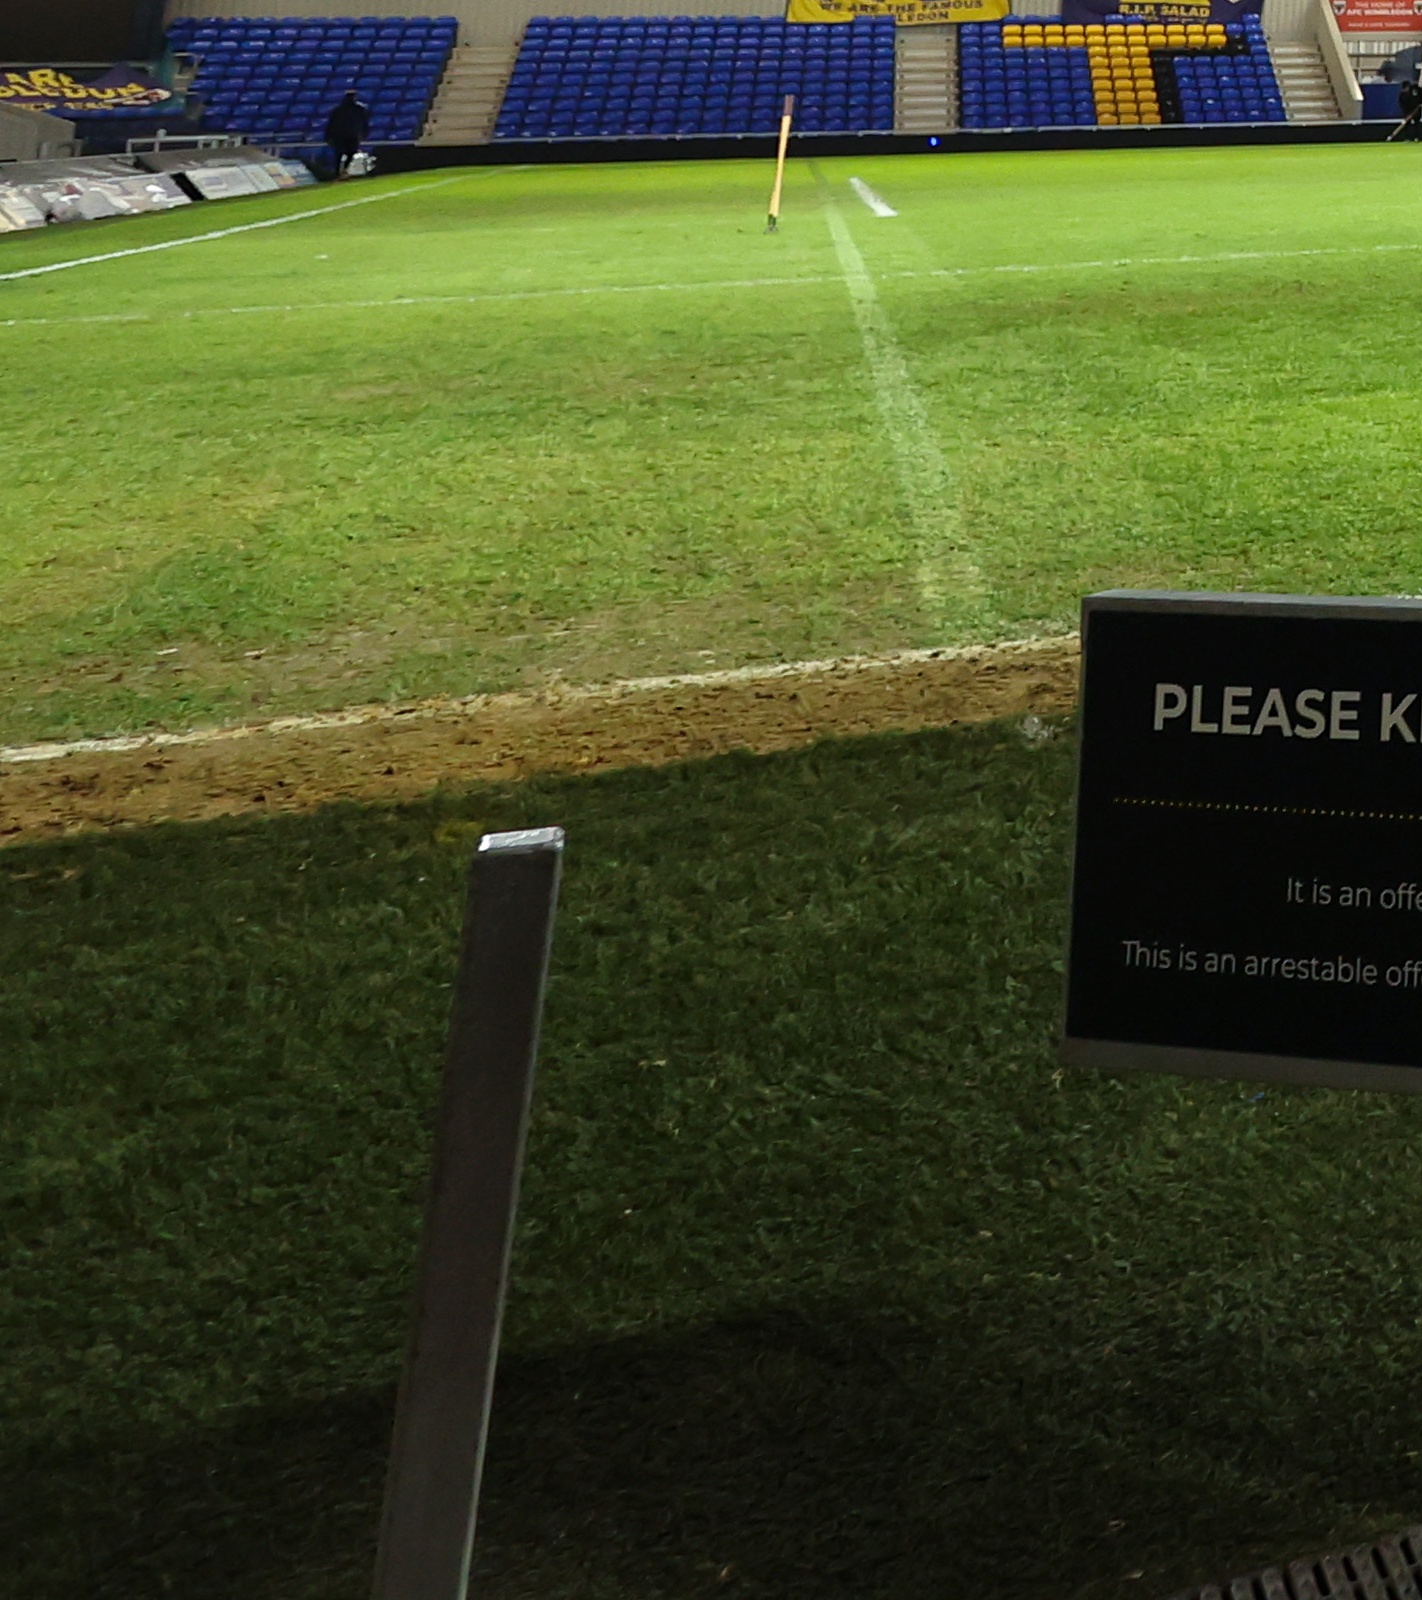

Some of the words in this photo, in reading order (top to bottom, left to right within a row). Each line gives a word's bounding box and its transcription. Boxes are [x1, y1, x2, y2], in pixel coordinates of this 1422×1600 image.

[1160, 4, 1211, 17] SALAD
[1153, 683, 1361, 740] PLEASE
[1287, 876, 1304, 904] It
[1312, 877, 1332, 906] is
[1338, 883, 1371, 908] an
[1122, 939, 1171, 970] This
[1178, 943, 1198, 972] is
[1204, 951, 1236, 975] an
[1244, 955, 1378, 986] arrestable
